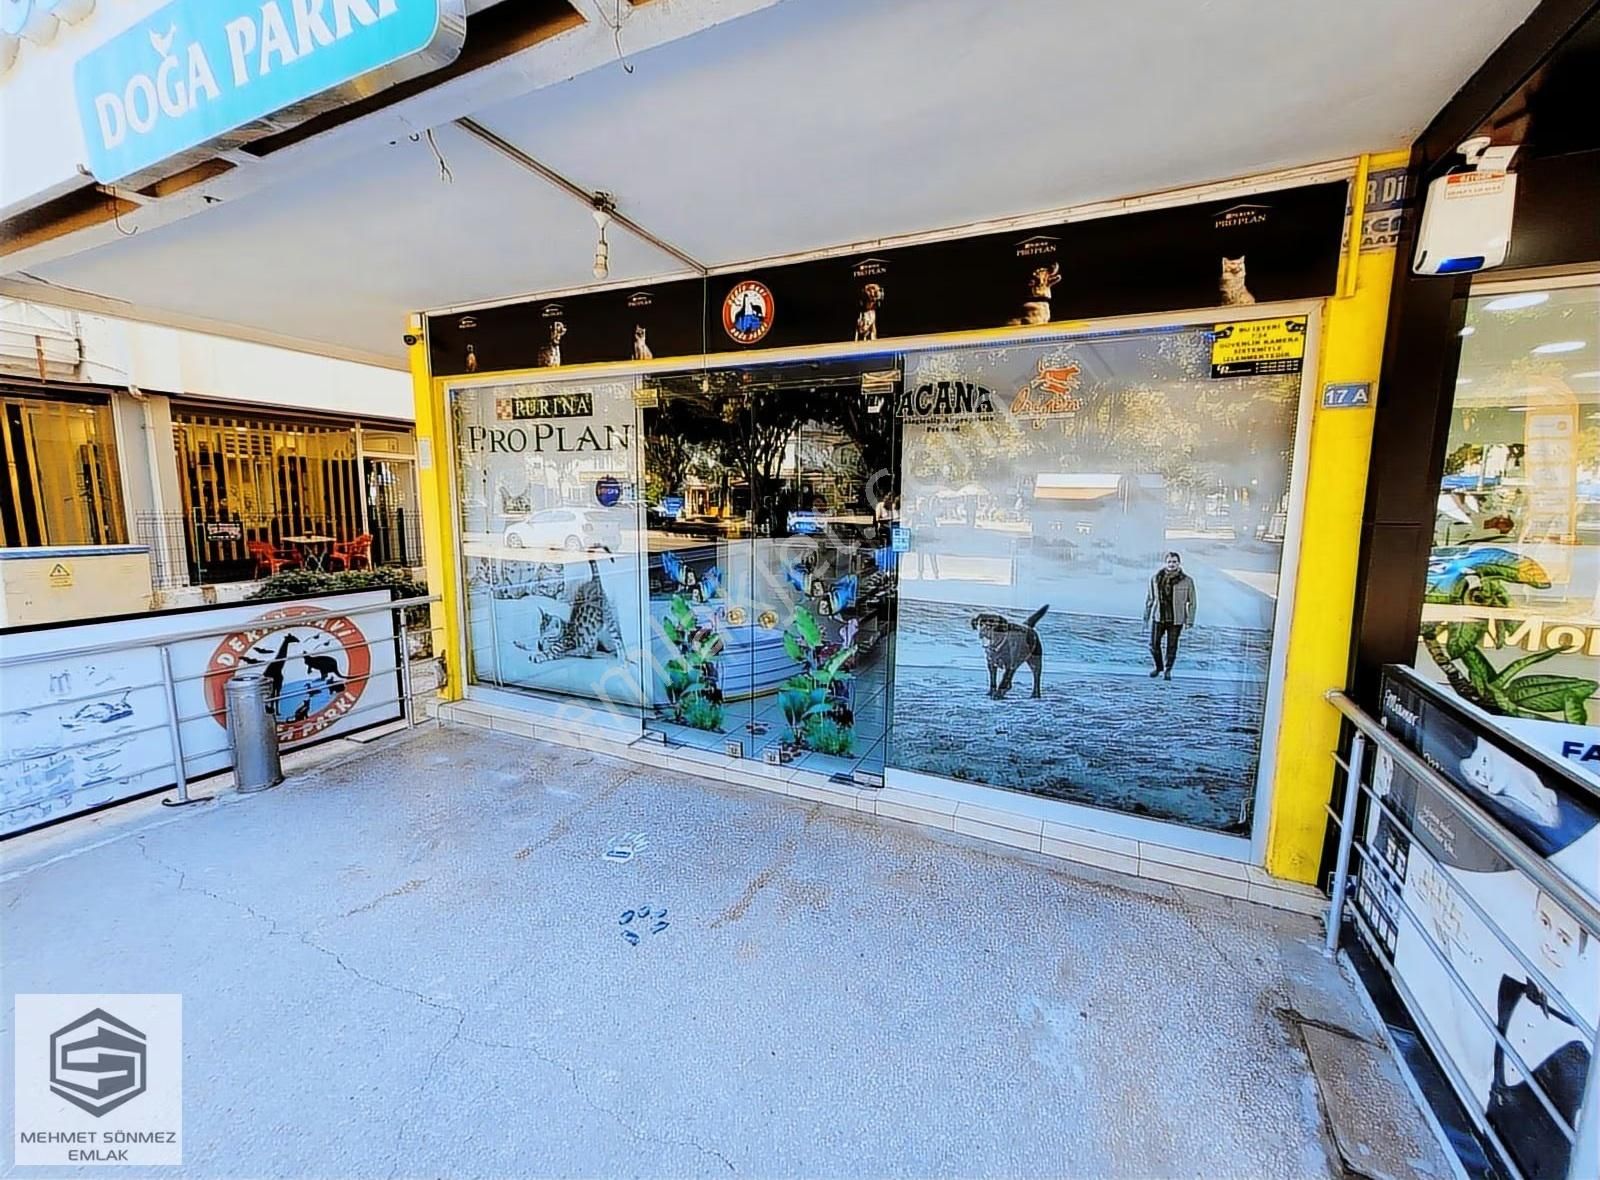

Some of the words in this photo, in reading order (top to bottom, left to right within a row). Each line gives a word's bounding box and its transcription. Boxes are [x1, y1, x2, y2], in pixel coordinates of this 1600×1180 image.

[94, 23, 221, 149] DOĞA
[225, 0, 398, 87] PARK
[514, 399, 592, 417] PURINA
[896, 381, 994, 418] ACANA
[1325, 389, 1349, 404] 17
[1351, 388, 1368, 403] A
[467, 424, 527, 454] PRO
[532, 423, 631, 453] PLAN
